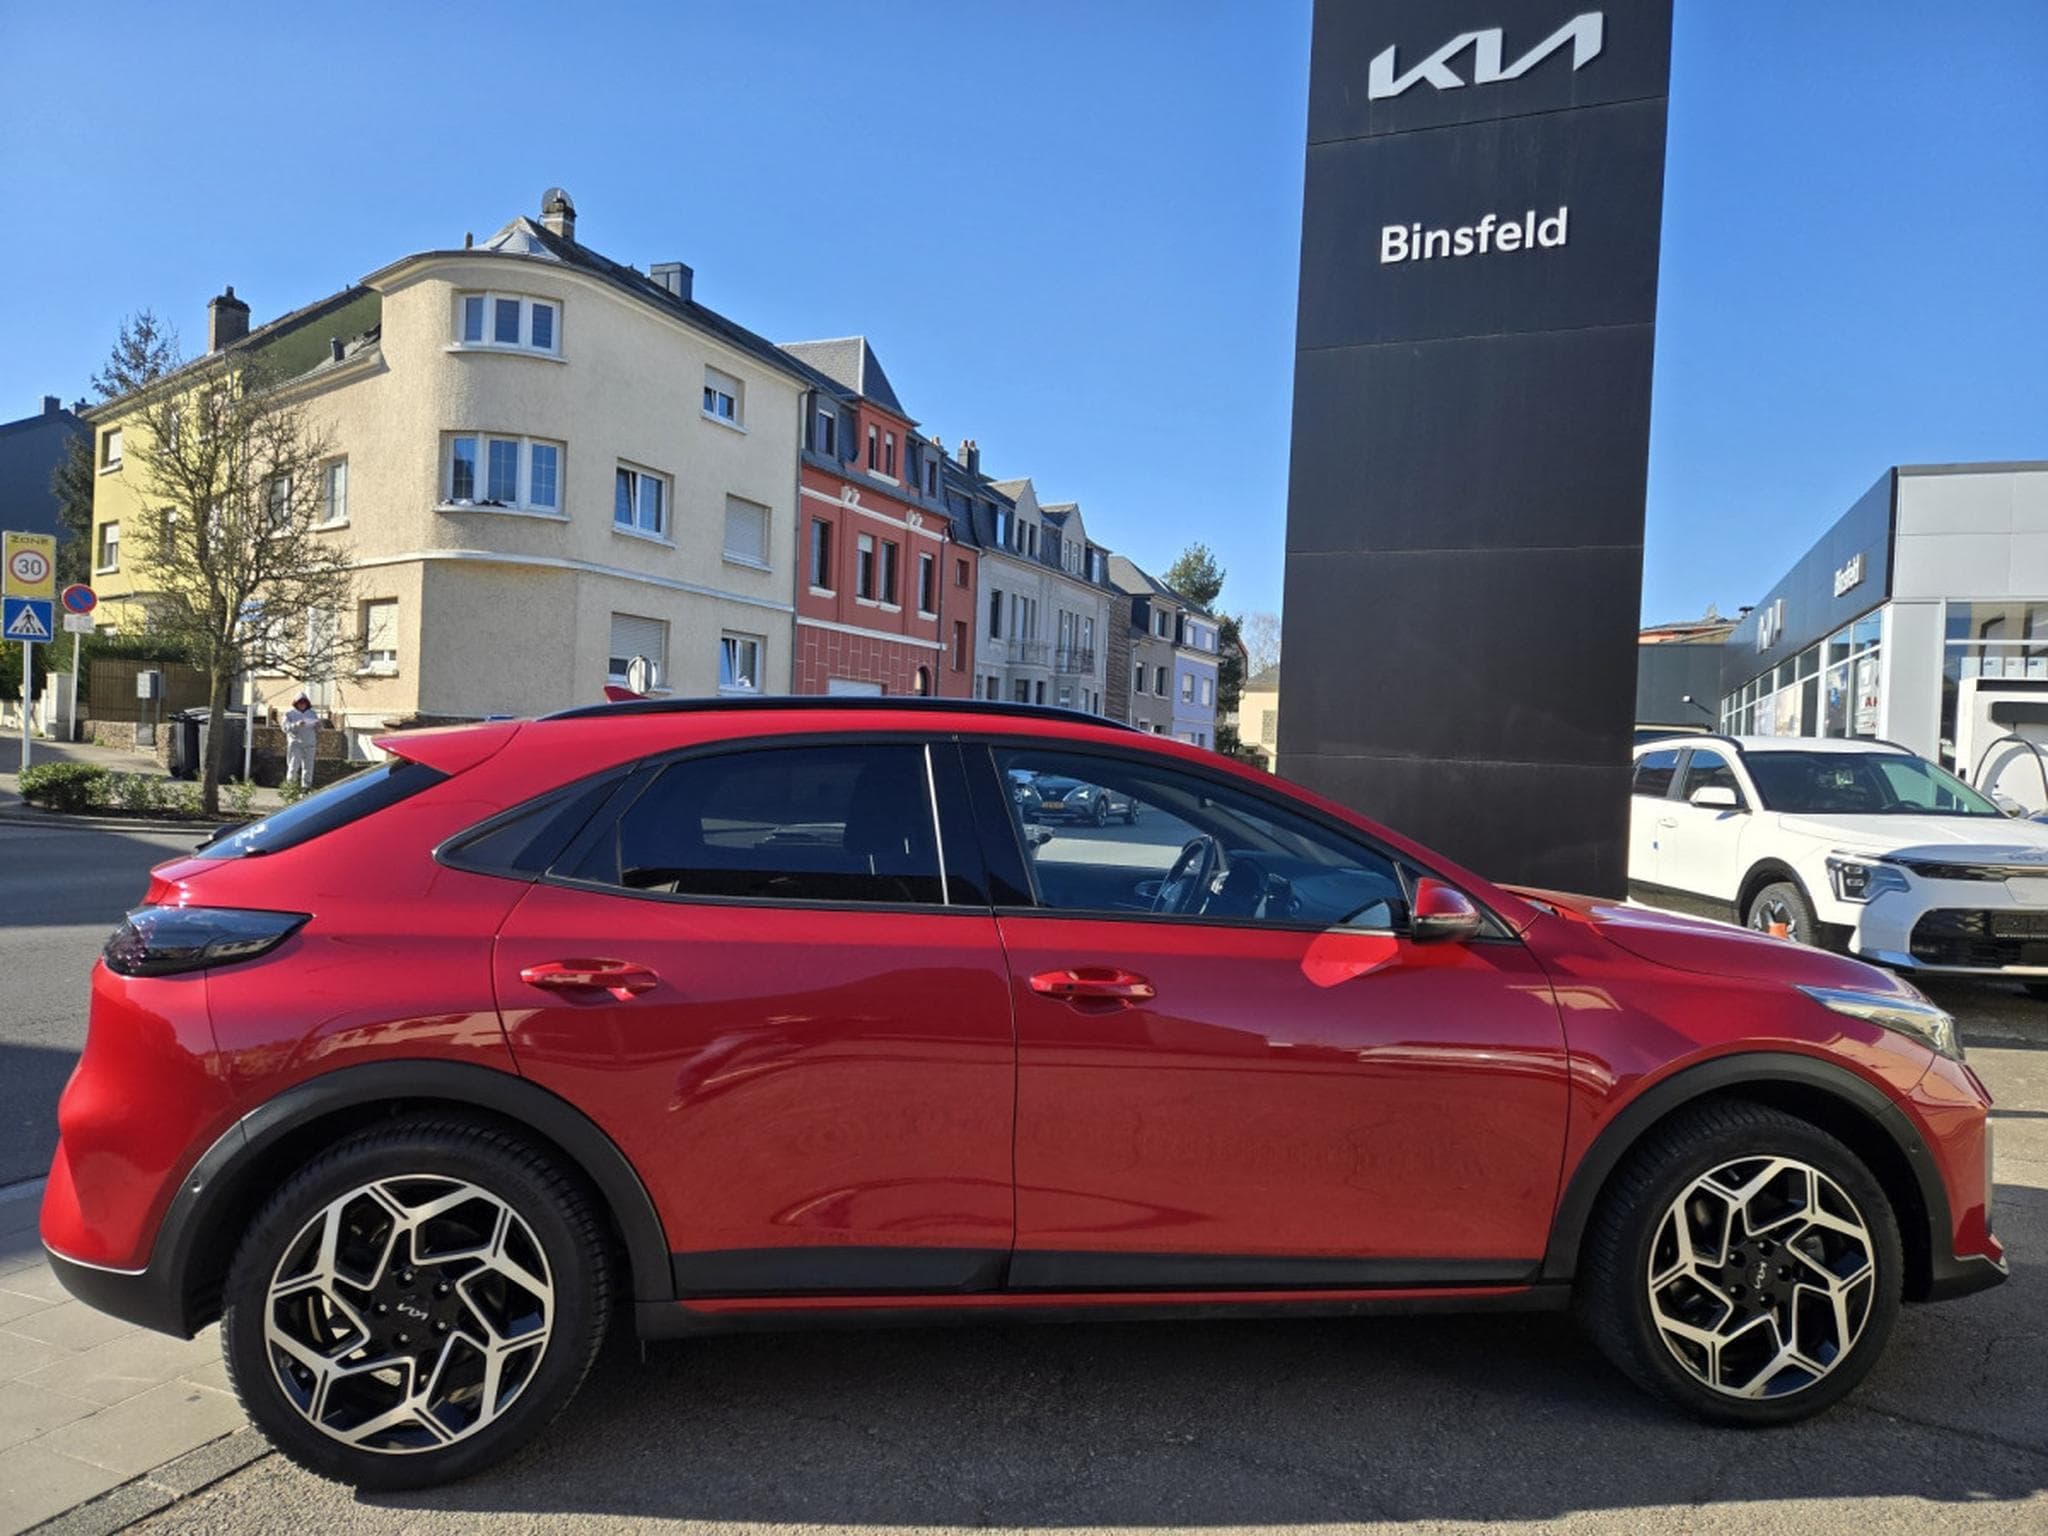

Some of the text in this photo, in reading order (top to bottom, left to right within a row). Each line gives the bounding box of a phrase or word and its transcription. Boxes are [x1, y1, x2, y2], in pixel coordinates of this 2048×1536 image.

[1381, 206, 1569, 264] Binsfeld
[10, 535, 49, 545] ZONE
[18, 559, 43, 576] 30
